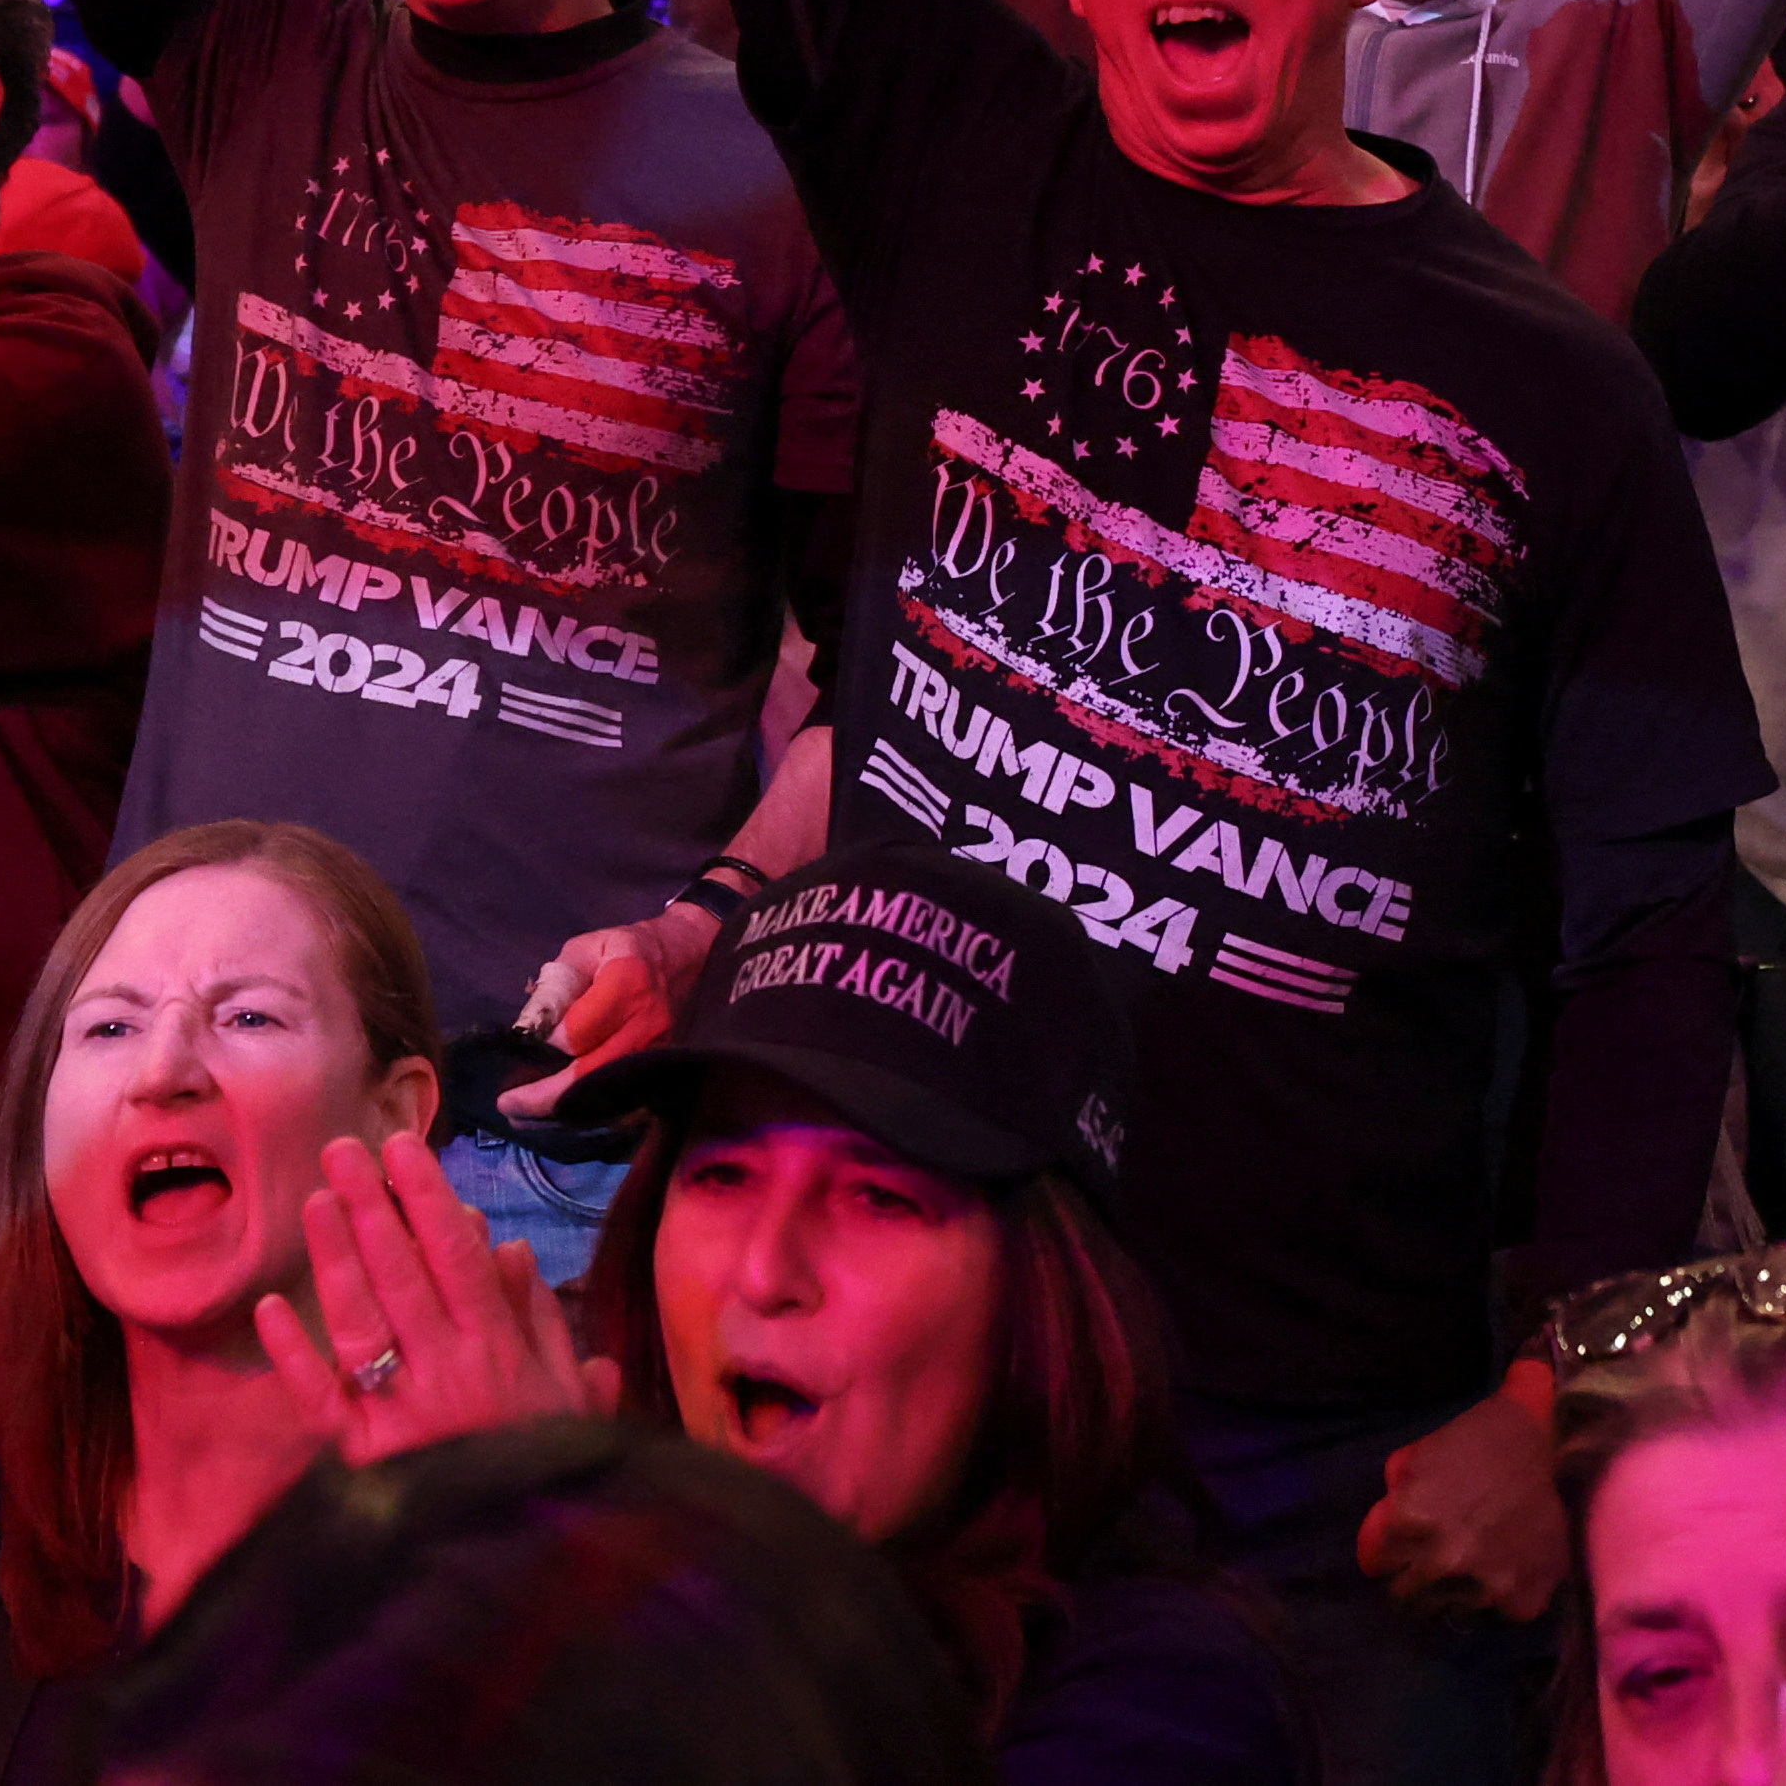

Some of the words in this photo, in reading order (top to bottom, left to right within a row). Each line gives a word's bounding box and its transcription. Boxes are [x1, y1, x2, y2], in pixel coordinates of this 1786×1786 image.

[229, 340, 301, 460] We
[317, 395, 423, 502] the
[428, 430, 681, 570] People
[209, 509, 401, 613] TRUMP
[411, 575, 659, 685] VANCE
[267, 619, 482, 719] 2024
[930, 459, 1016, 616] We
[1035, 553, 1158, 685] the
[1165, 608, 1451, 804] People
[888, 641, 1116, 814] TRUMP
[1127, 783, 1414, 942] VANCE
[734, 883, 839, 952] MAKE
[826, 885, 1017, 1004] AMERICA
[950, 809, 1200, 975] 2024
[728, 942, 844, 1005] GREAT
[836, 949, 978, 1047] AGAIN
